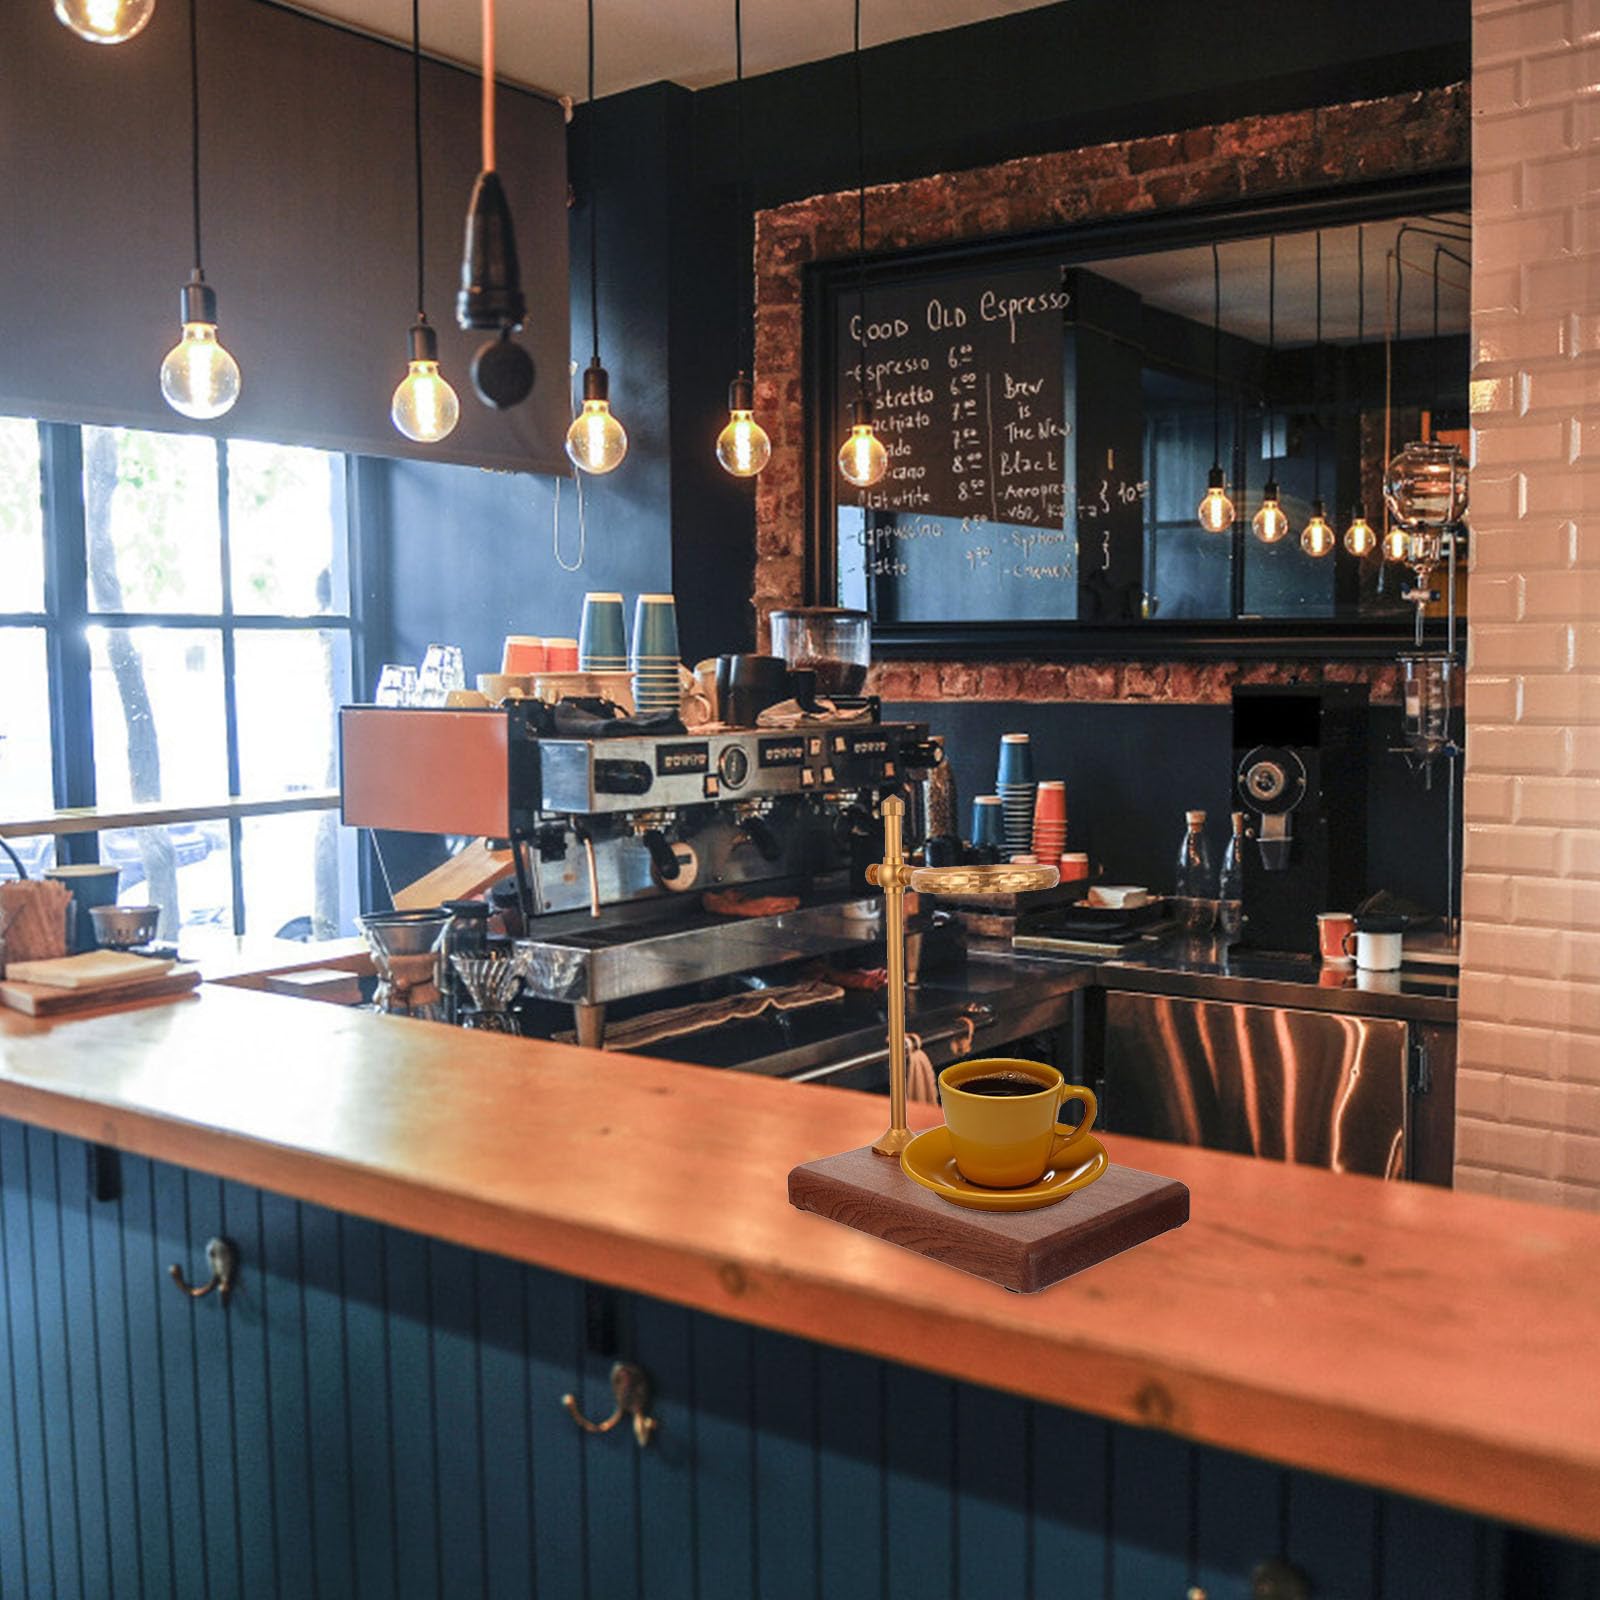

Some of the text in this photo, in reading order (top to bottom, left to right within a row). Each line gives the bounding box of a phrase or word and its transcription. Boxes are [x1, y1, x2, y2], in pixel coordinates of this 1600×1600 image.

[927, 299, 966, 331] OLD
[1003, 373, 1044, 400] Brew
[1017, 402, 1031, 420] is
[1000, 451, 1058, 477] Black
